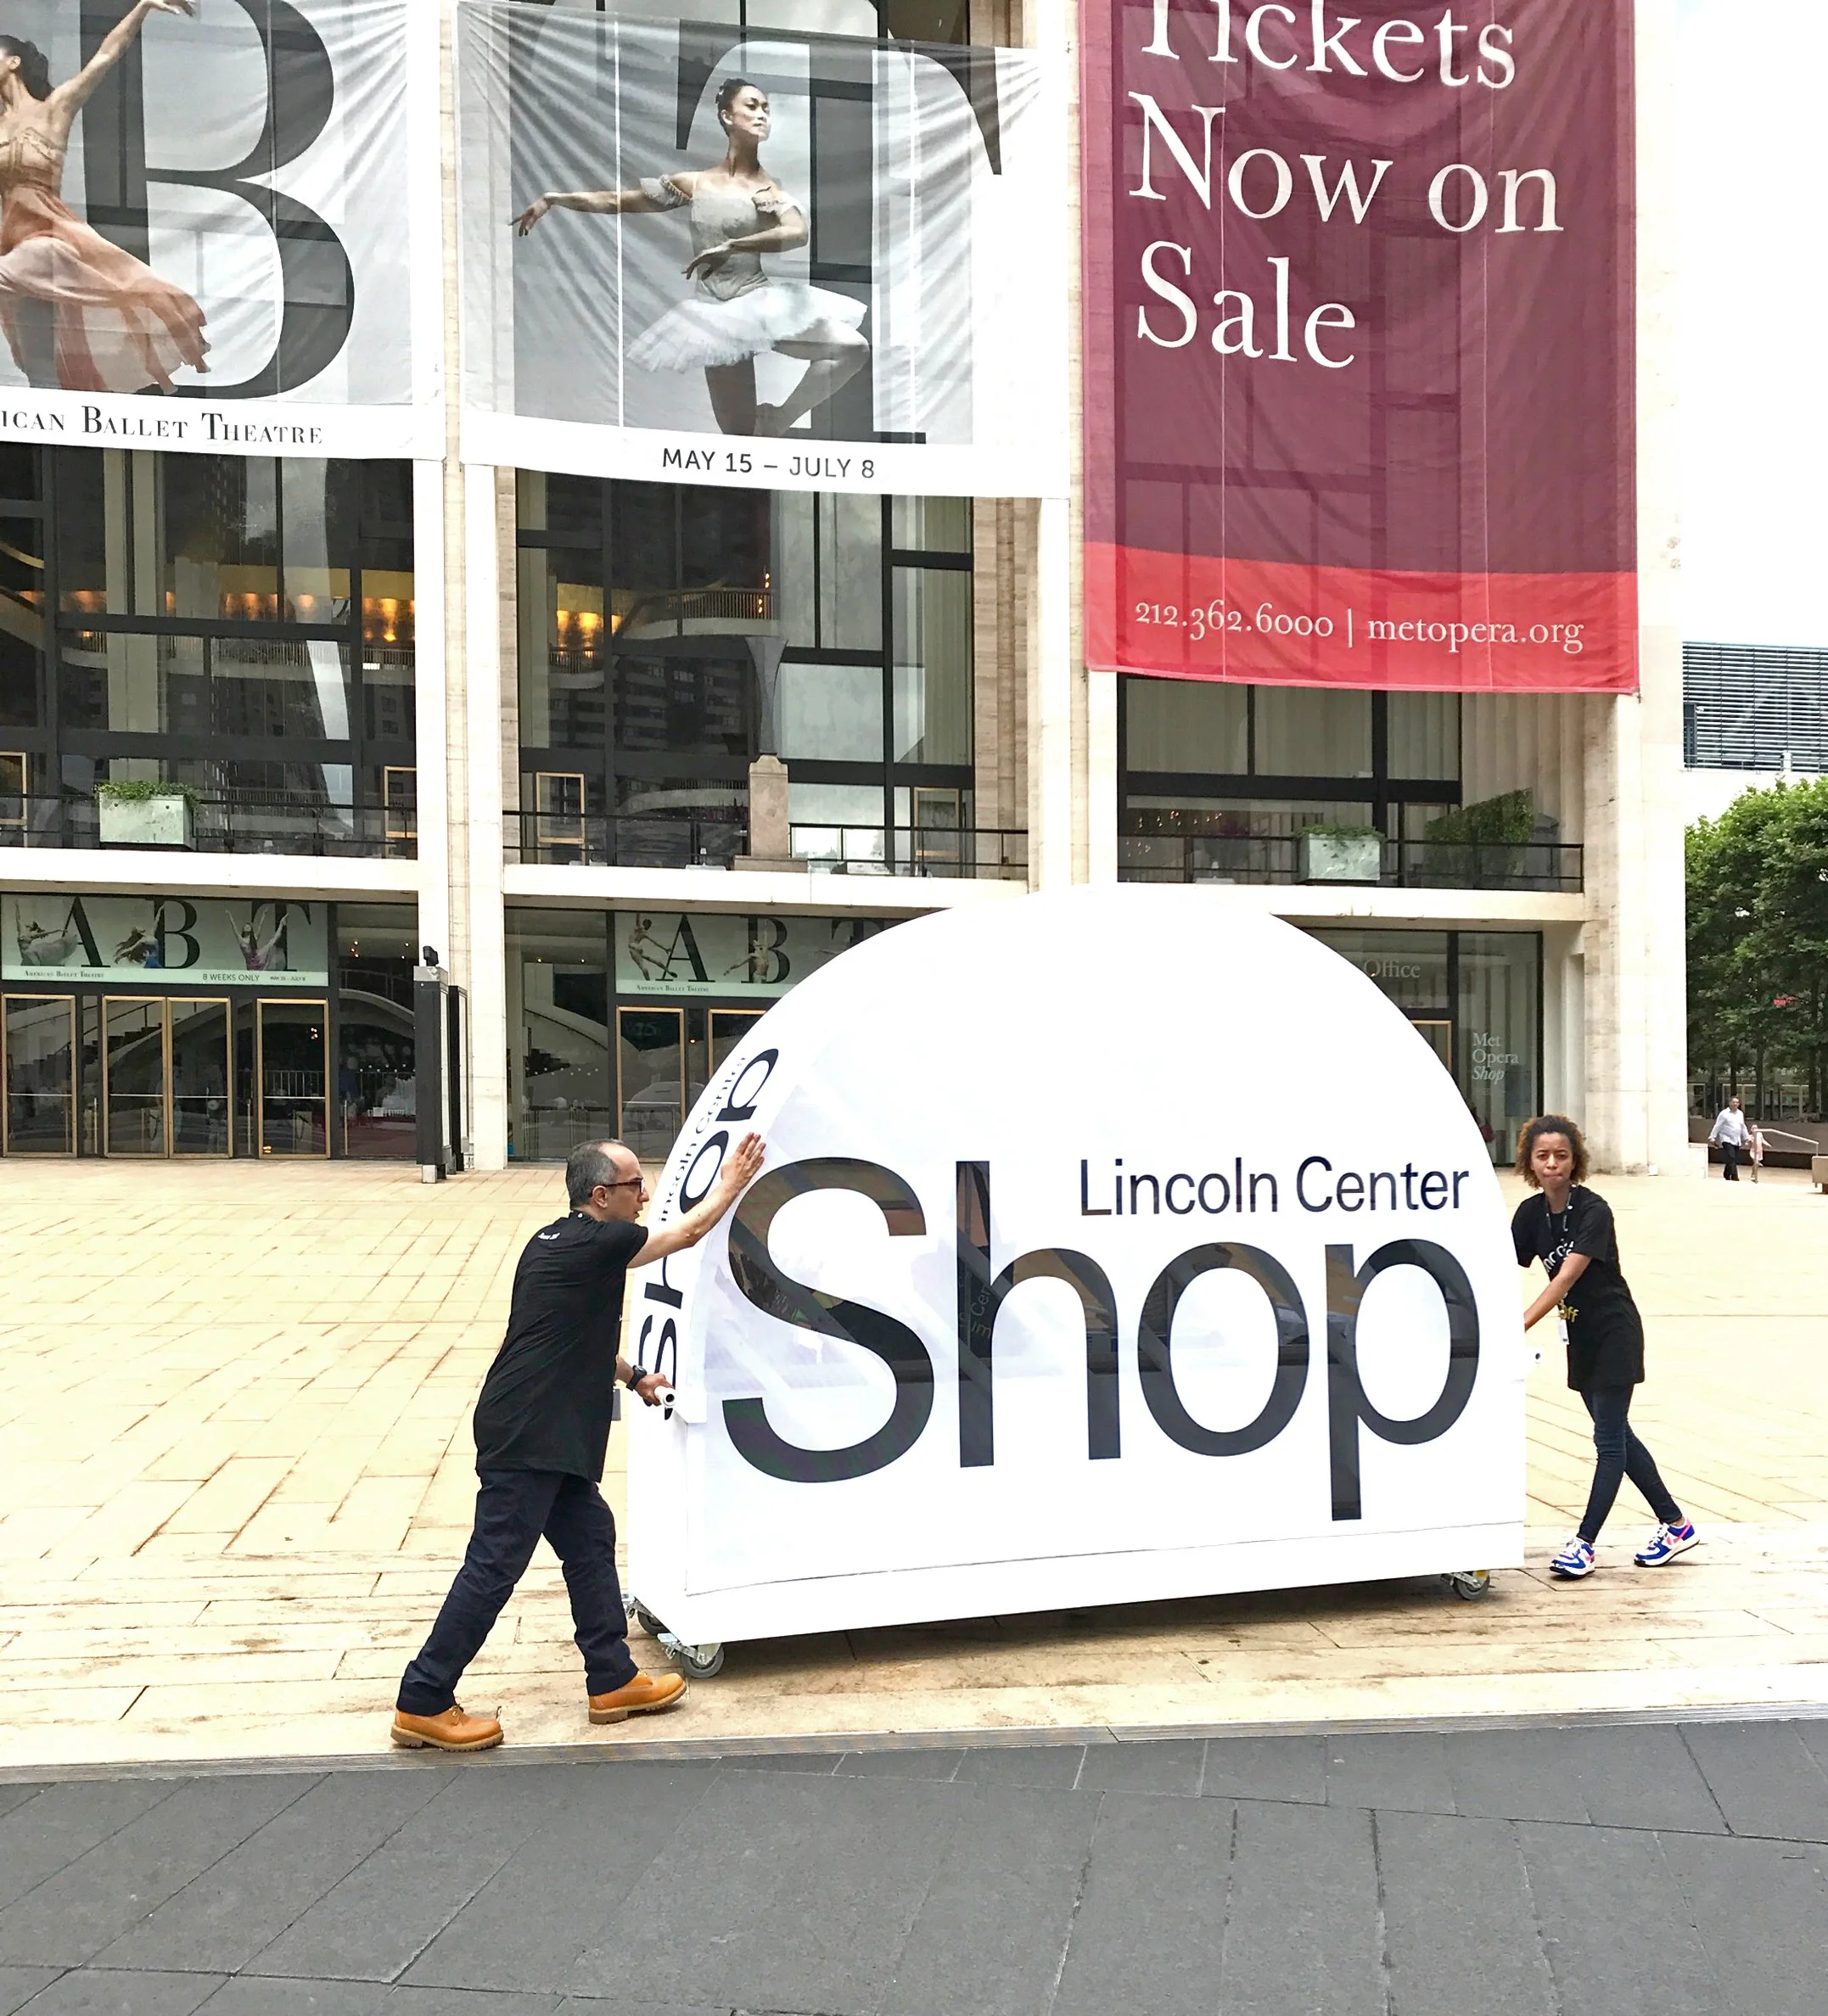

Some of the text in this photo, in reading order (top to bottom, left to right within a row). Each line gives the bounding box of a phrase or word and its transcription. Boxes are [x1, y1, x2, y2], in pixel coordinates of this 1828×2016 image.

[1128, 90, 1564, 233] Now on
[1137, 240, 1356, 368] Sale
[81, 405, 188, 439] BALLET
[201, 412, 322, 444] THEATRE
[663, 448, 715, 470] MAY
[726, 452, 752, 473] 15
[789, 456, 851, 478] JULY
[861, 459, 874, 479] 8
[1135, 599, 1334, 641] 212.362.6000
[1367, 619, 1585, 654] metopera.org
[1363, 959, 1421, 978] Office
[1472, 1033, 1501, 1047] Met
[1472, 1049, 1519, 1066] Opera
[1472, 1066, 1505, 1084] Shop
[1080, 1156, 1470, 1217] Lincoln Center
[721, 1157, 1481, 1521] Shop
